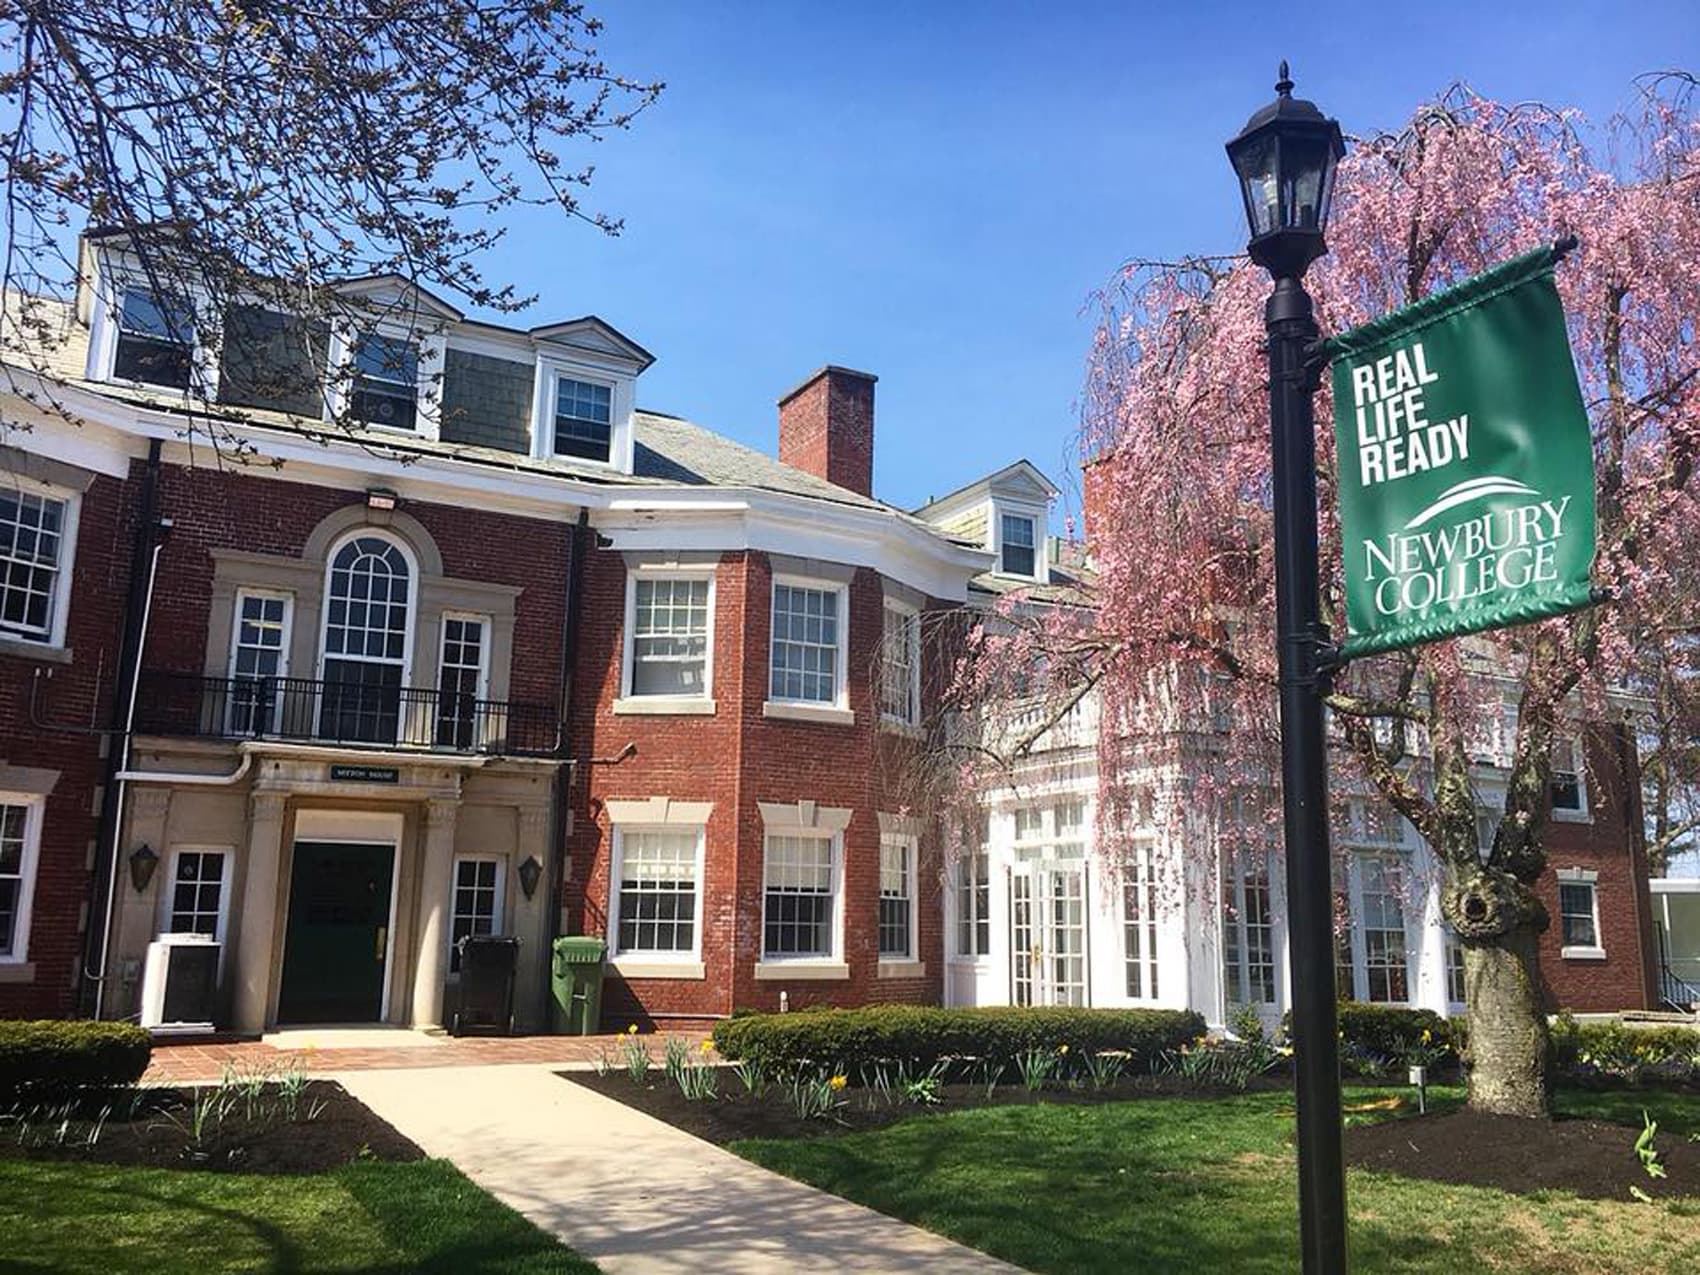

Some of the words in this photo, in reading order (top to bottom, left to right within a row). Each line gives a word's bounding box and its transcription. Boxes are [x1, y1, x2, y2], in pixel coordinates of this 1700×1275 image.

[1352, 343, 1439, 406] REAL
[1356, 387, 1429, 446] LIFE
[1359, 414, 1469, 486] READY
[1362, 496, 1572, 581] NEWBURY
[1376, 541, 1558, 615] COLLEGE
